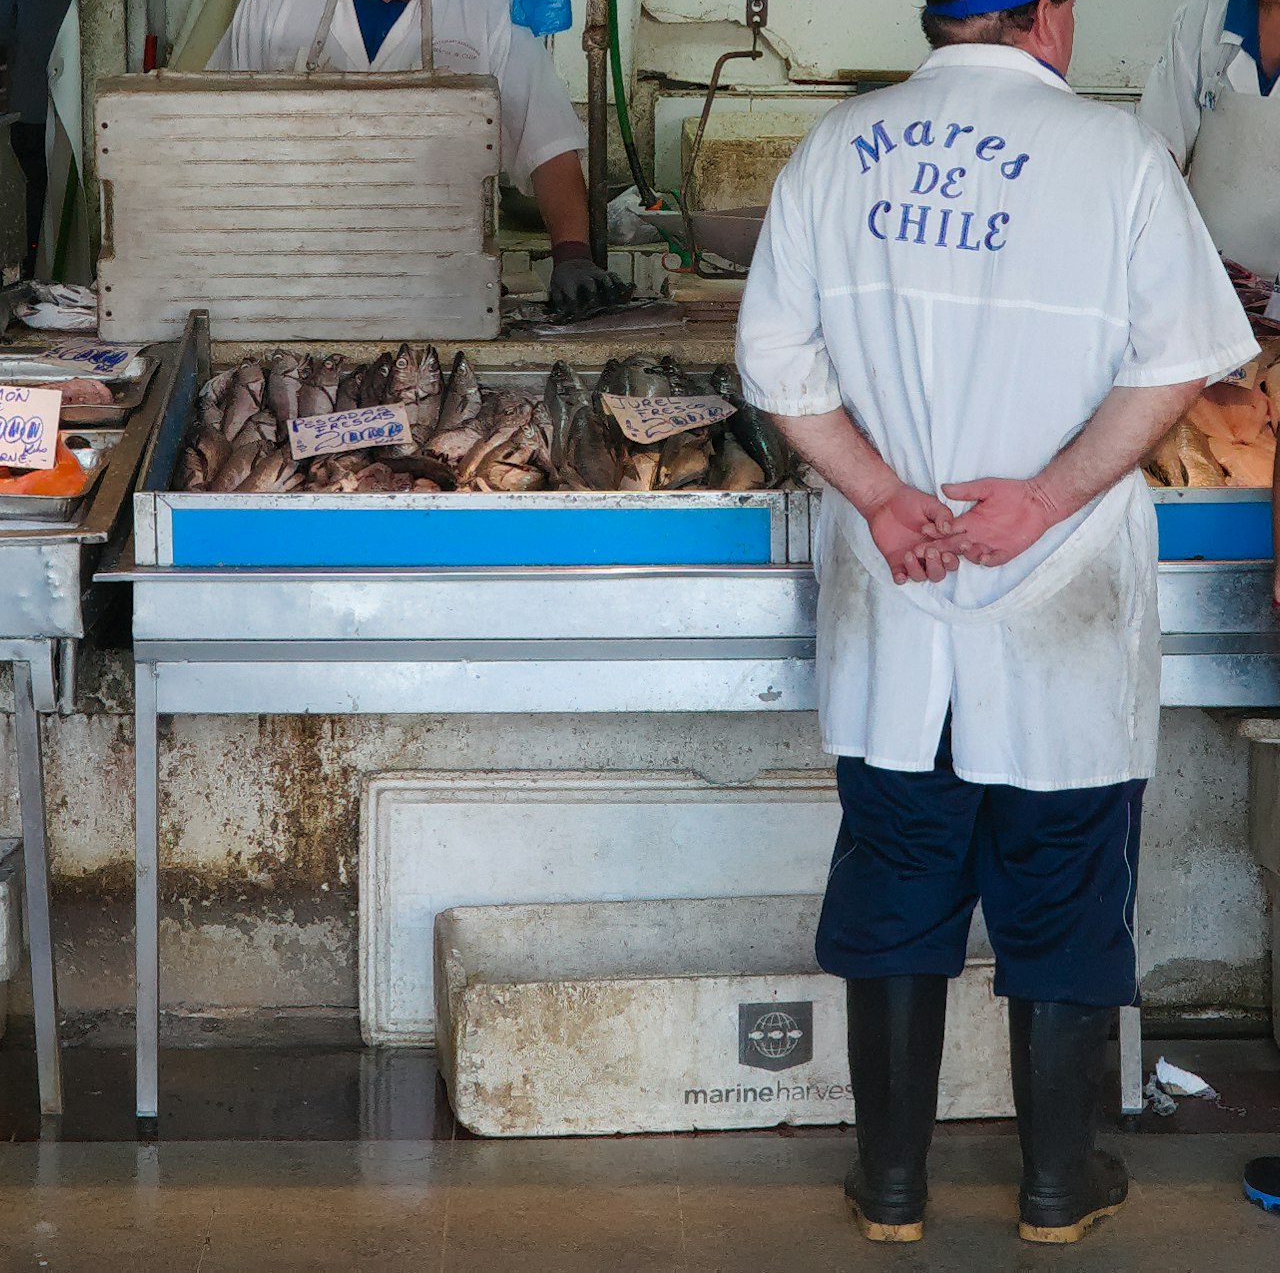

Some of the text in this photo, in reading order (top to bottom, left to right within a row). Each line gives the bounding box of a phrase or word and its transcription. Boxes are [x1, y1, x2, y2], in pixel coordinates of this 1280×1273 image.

[851, 119, 1030, 179] Mares
[911, 162, 965, 198] DE
[868, 200, 1010, 251] CHILE
[610, 397, 682, 410] JUREL
[314, 412, 396, 434] FRESCAS
[684, 1080, 856, 1105] marineharves
